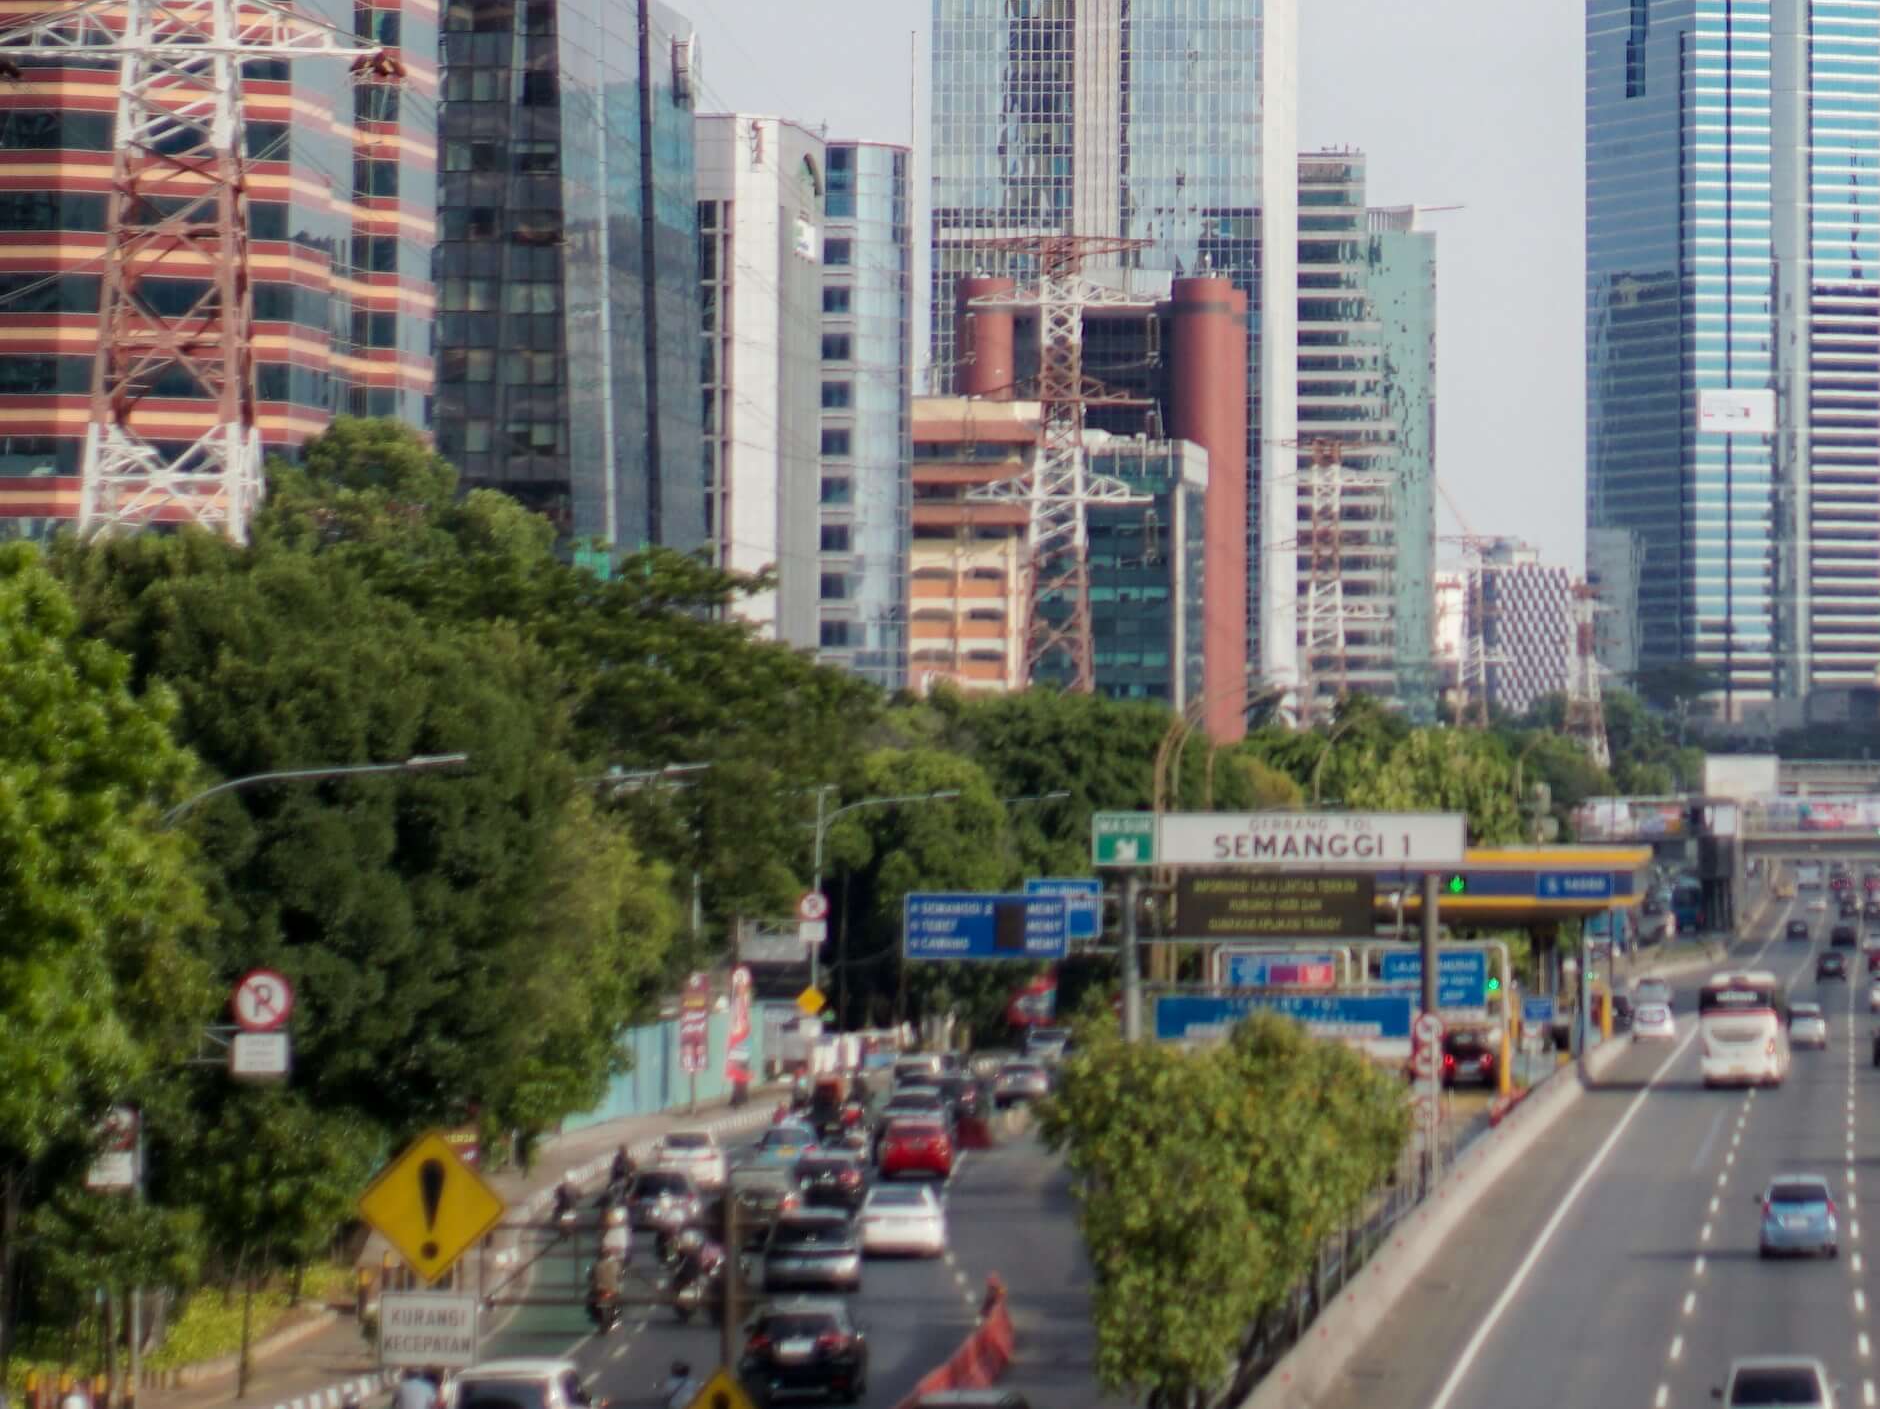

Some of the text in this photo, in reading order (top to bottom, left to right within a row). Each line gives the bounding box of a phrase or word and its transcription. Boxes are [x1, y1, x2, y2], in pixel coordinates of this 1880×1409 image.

[1250, 818, 1373, 831] GERBANG TOL
[1213, 834, 1411, 858] SEMANGGI 1
[391, 1309, 466, 1327] KURANGI
[383, 1336, 472, 1352] KECEPATAN
